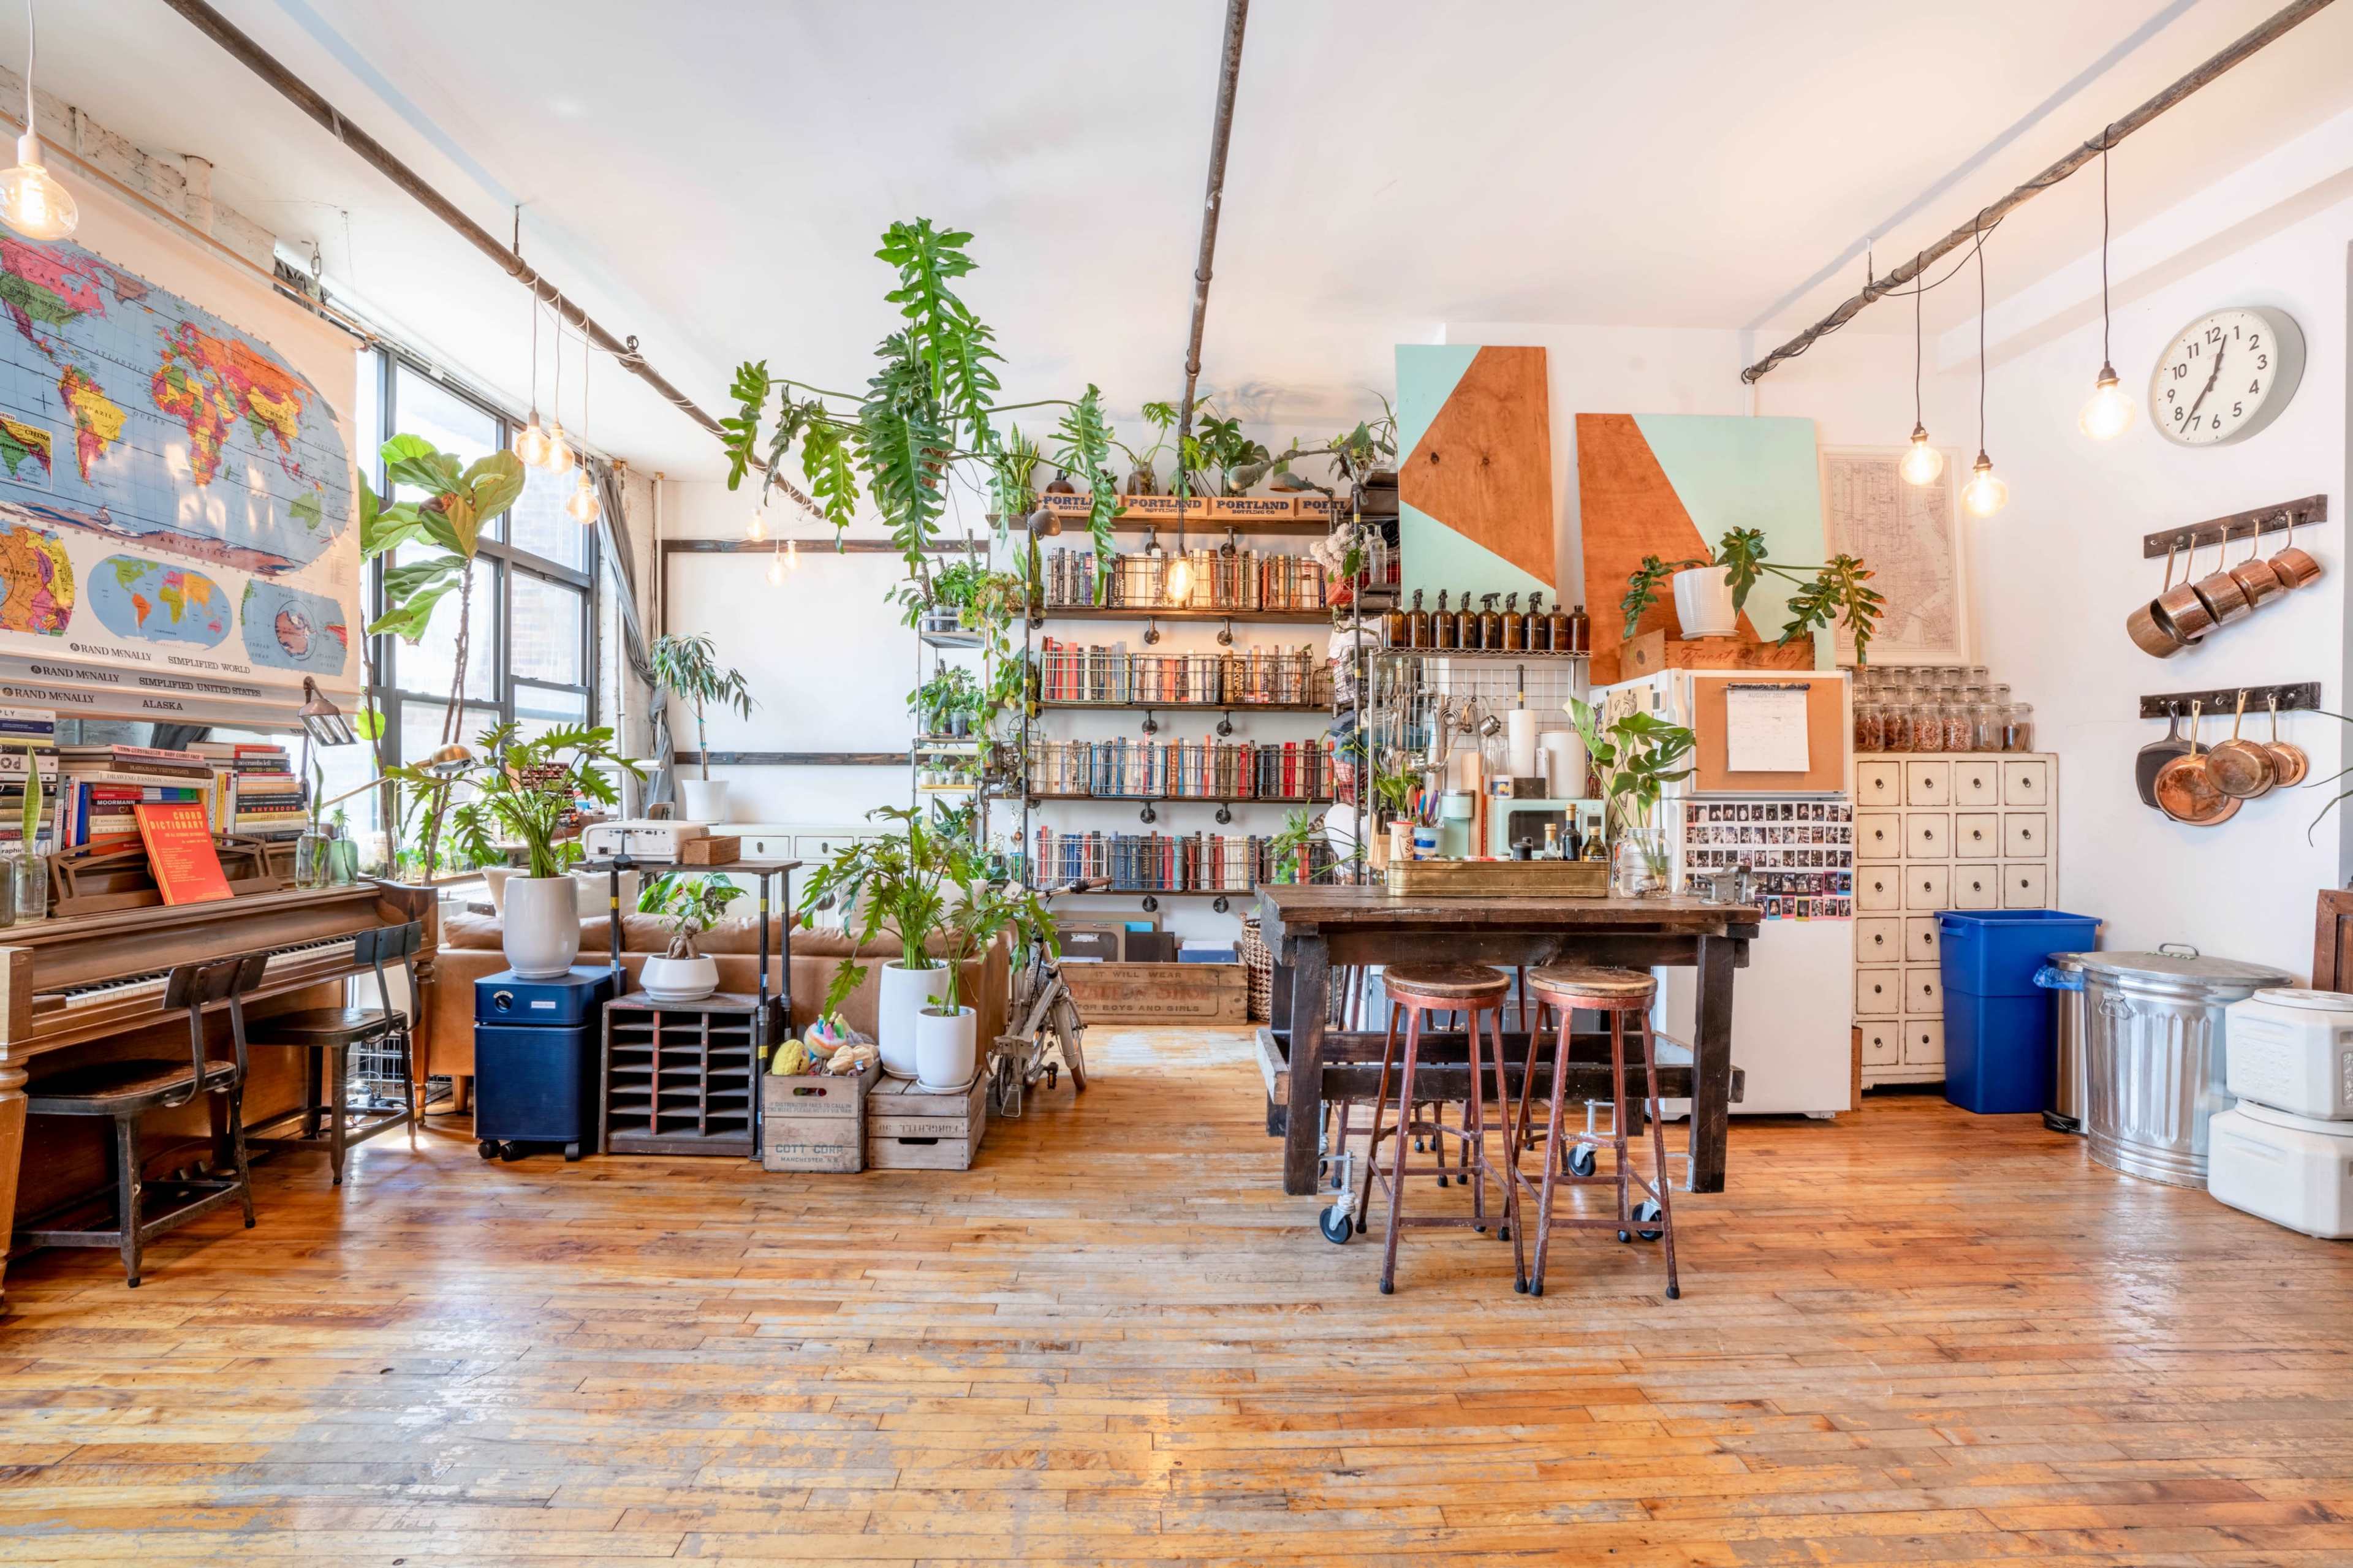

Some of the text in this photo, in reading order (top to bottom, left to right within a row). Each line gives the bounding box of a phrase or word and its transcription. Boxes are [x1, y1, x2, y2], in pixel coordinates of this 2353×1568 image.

[28, 268, 85, 297] CANADA
[2205, 327, 2221, 344] 12
[2234, 325, 2240, 339] 1
[2249, 334, 2259, 350] 2
[2187, 342, 2199, 358] 11
[94, 349, 143, 372] ATLANTIC
[2257, 354, 2267, 369] 3
[2172, 363, 2187, 380] 10
[2249, 379, 2259, 394] 4
[2167, 389, 2175, 403] 9
[84, 405, 113, 419] BRAZIL
[265, 409, 289, 421] CHINA
[2175, 406, 2183, 421] 8
[2232, 401, 2241, 417] 5
[133, 411, 165, 425] OCEAN
[2192, 415, 2201, 431] 7
[2212, 414, 2221, 429] 6
[1044, 496, 1094, 506] PORTL
[1129, 498, 1202, 508] PORTLAND
[1216, 500, 1289, 510] PORTLAND
[160, 537, 232, 559] ANTARCTICA
[4, 567, 37, 578] RUSSIA
[81, 644, 251, 674] RAND McNALLY SIMPLIFIED WORLD
[1676, 646, 1804, 668] Finest Quality
[43, 667, 261, 697] RAND McNALLY SIMPLIFIED UNITED STATES
[15, 689, 183, 710] RAND McNALLY ALASKA
[107, 773, 136, 782] DRAWING
[173, 811, 202, 820] CHORD
[150, 820, 204, 830] DICTIONARY
[775, 1143, 806, 1153] COTT
